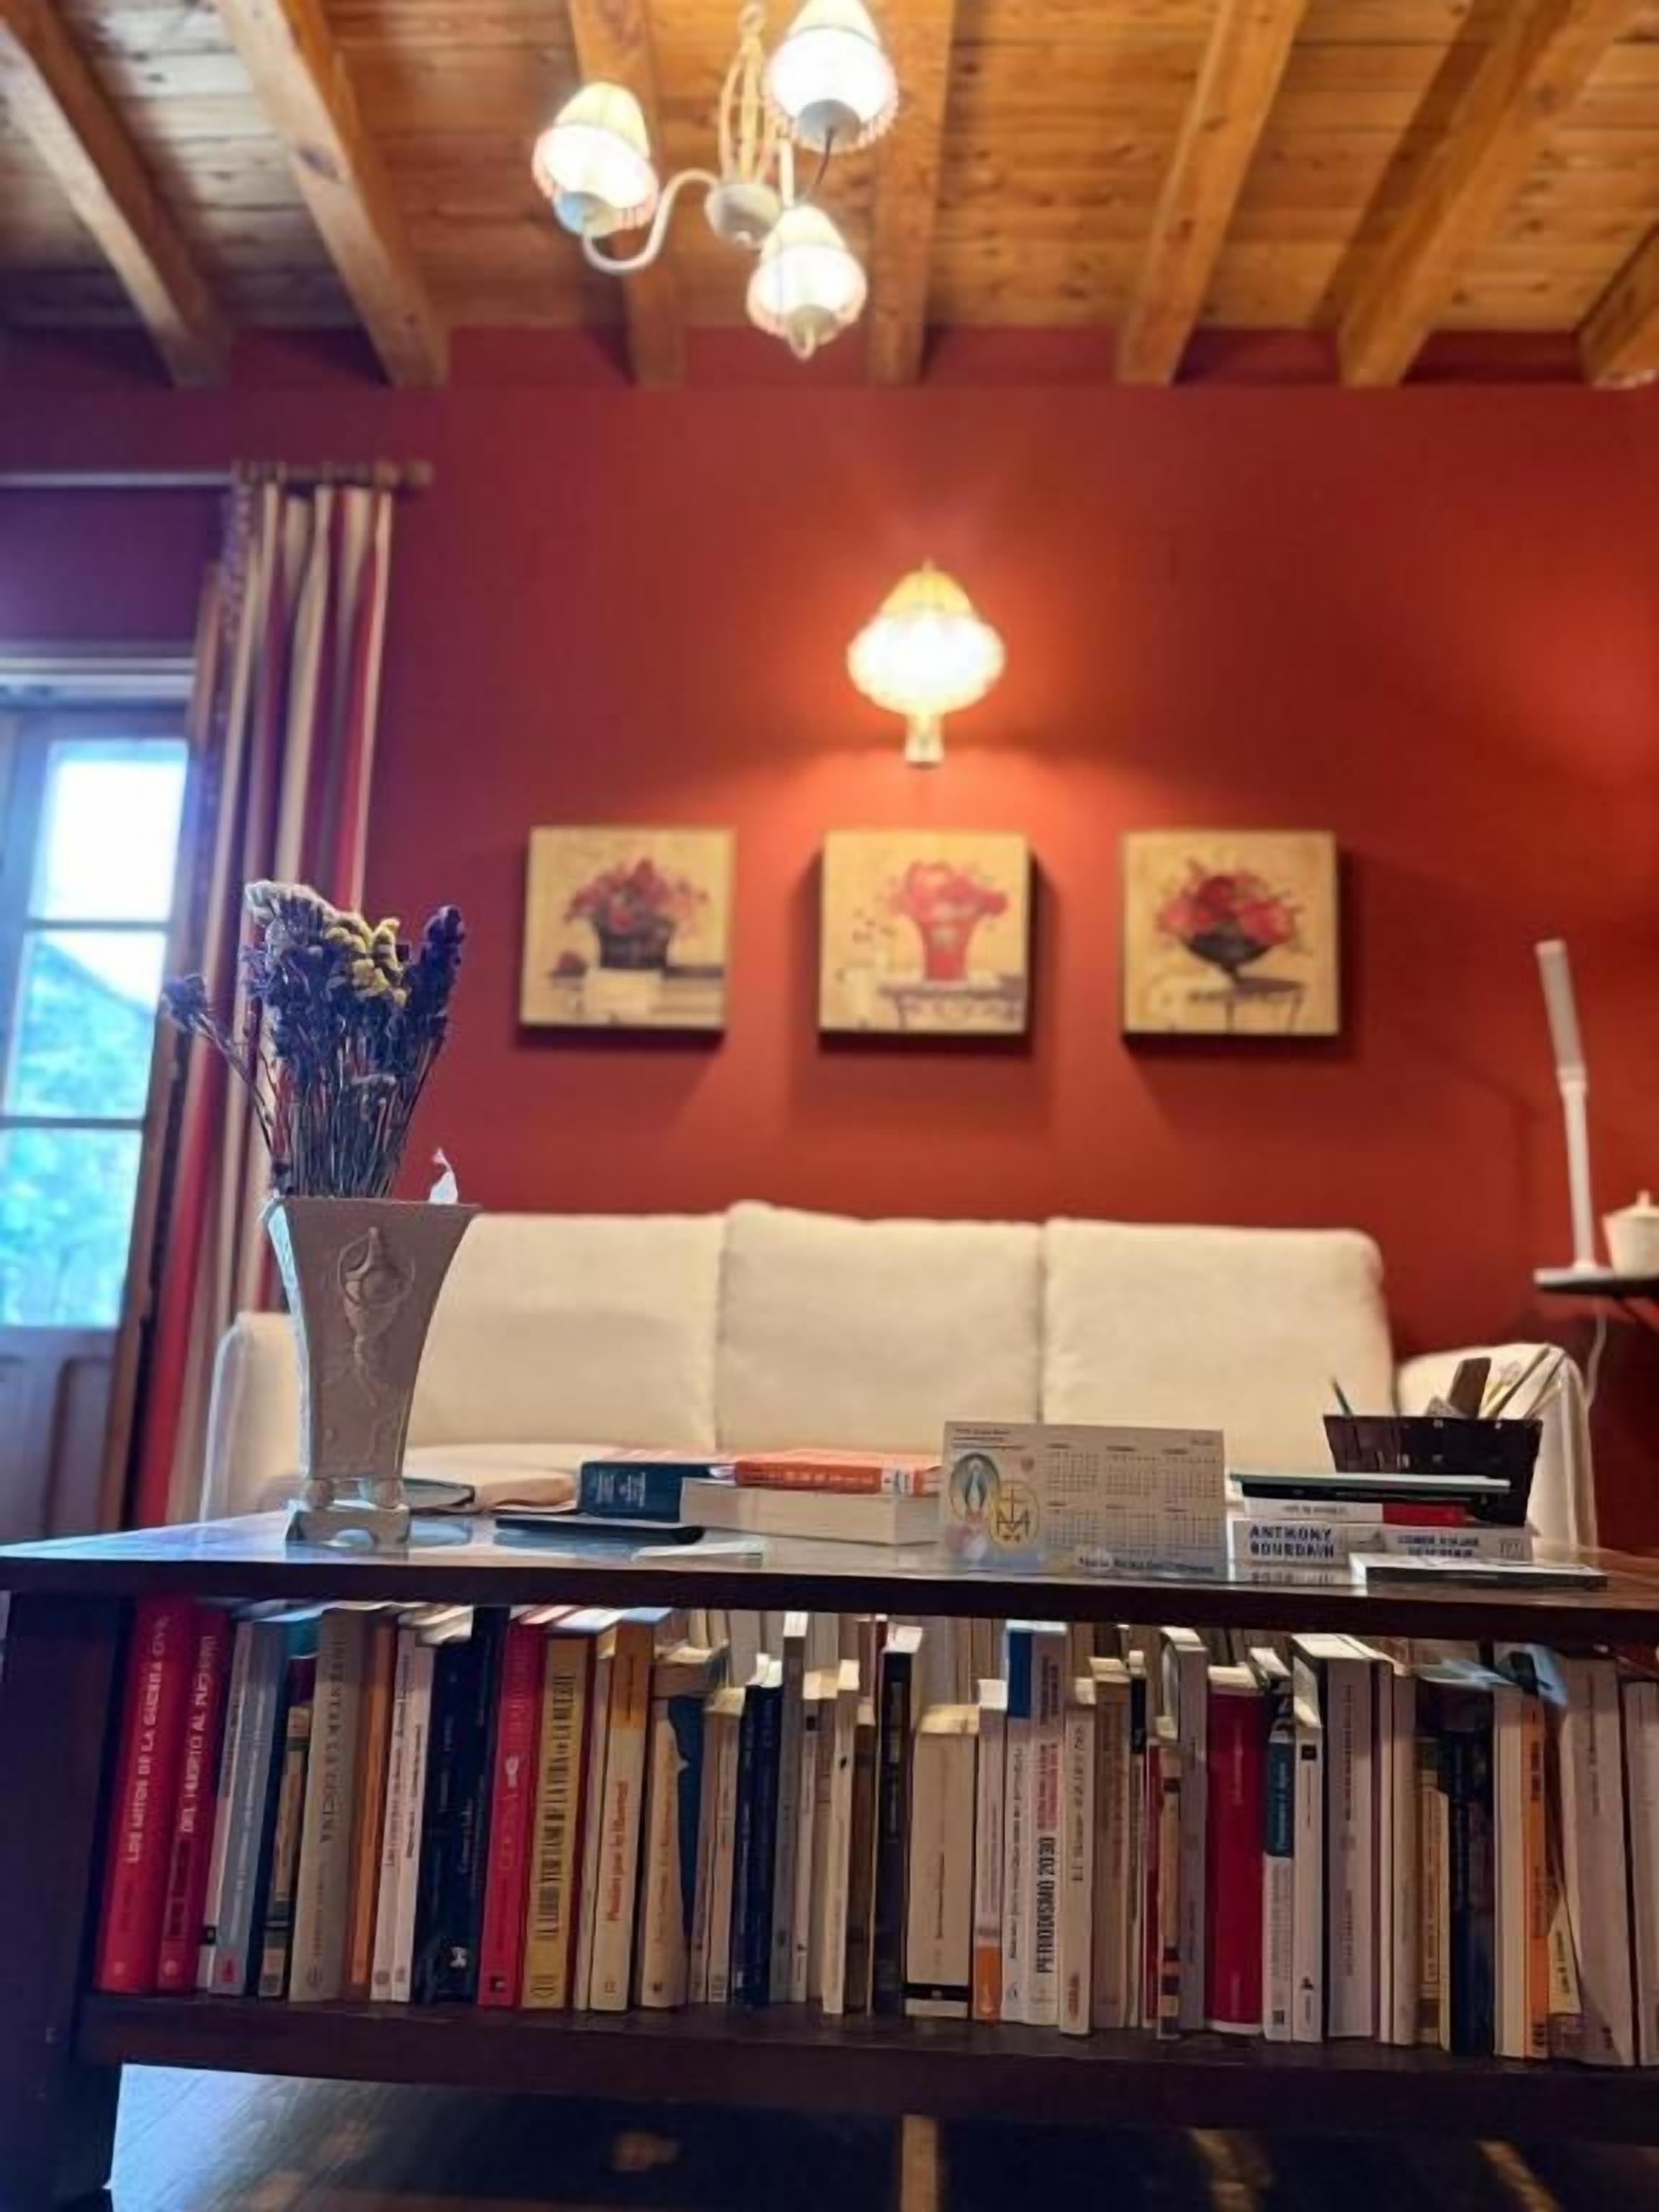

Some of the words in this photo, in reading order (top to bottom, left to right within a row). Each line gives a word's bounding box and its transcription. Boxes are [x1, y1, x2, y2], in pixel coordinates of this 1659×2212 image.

[1250, 1524, 1331, 1541] ANTHONY
[140, 1728, 155, 1752] LA
[1036, 1837, 1056, 1876] 2030
[1035, 1879, 1056, 1973] PERIODISMO
